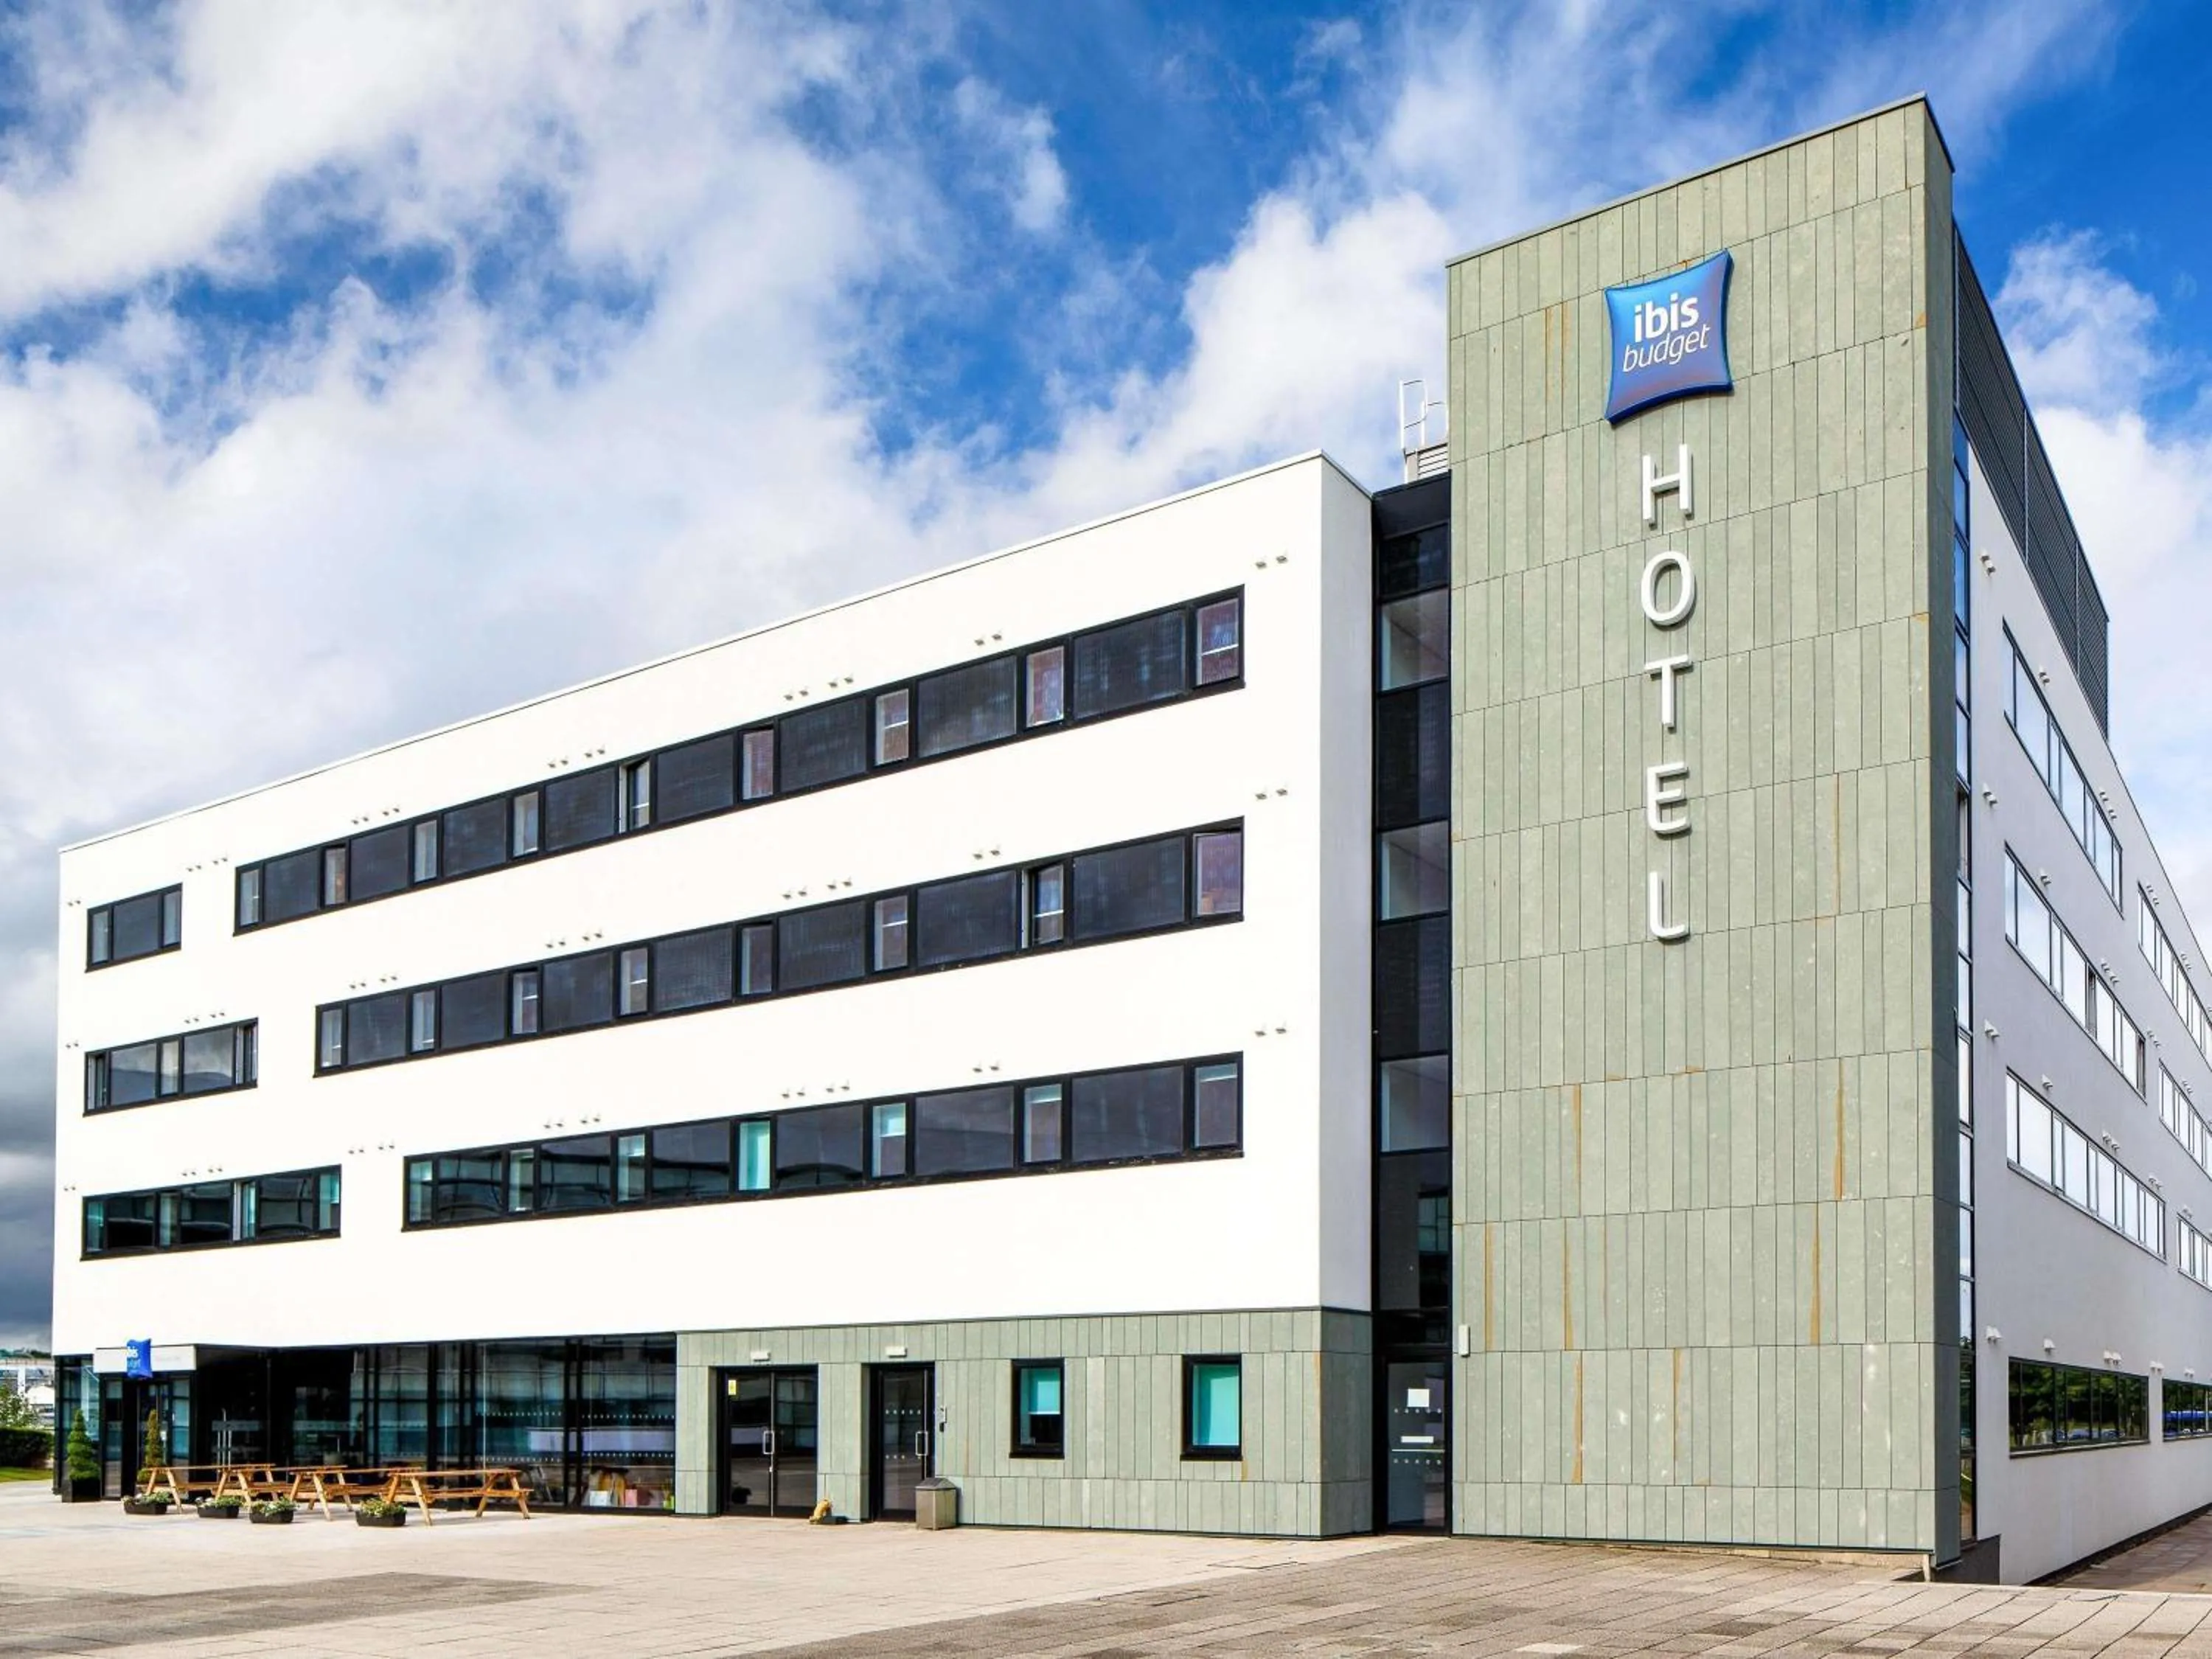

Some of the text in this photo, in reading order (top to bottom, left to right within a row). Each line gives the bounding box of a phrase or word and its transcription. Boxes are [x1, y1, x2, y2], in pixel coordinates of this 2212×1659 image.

[1635, 293, 1699, 343] ibis
[1623, 324, 1711, 372] budget
[1641, 444, 1694, 939] HOTEL
